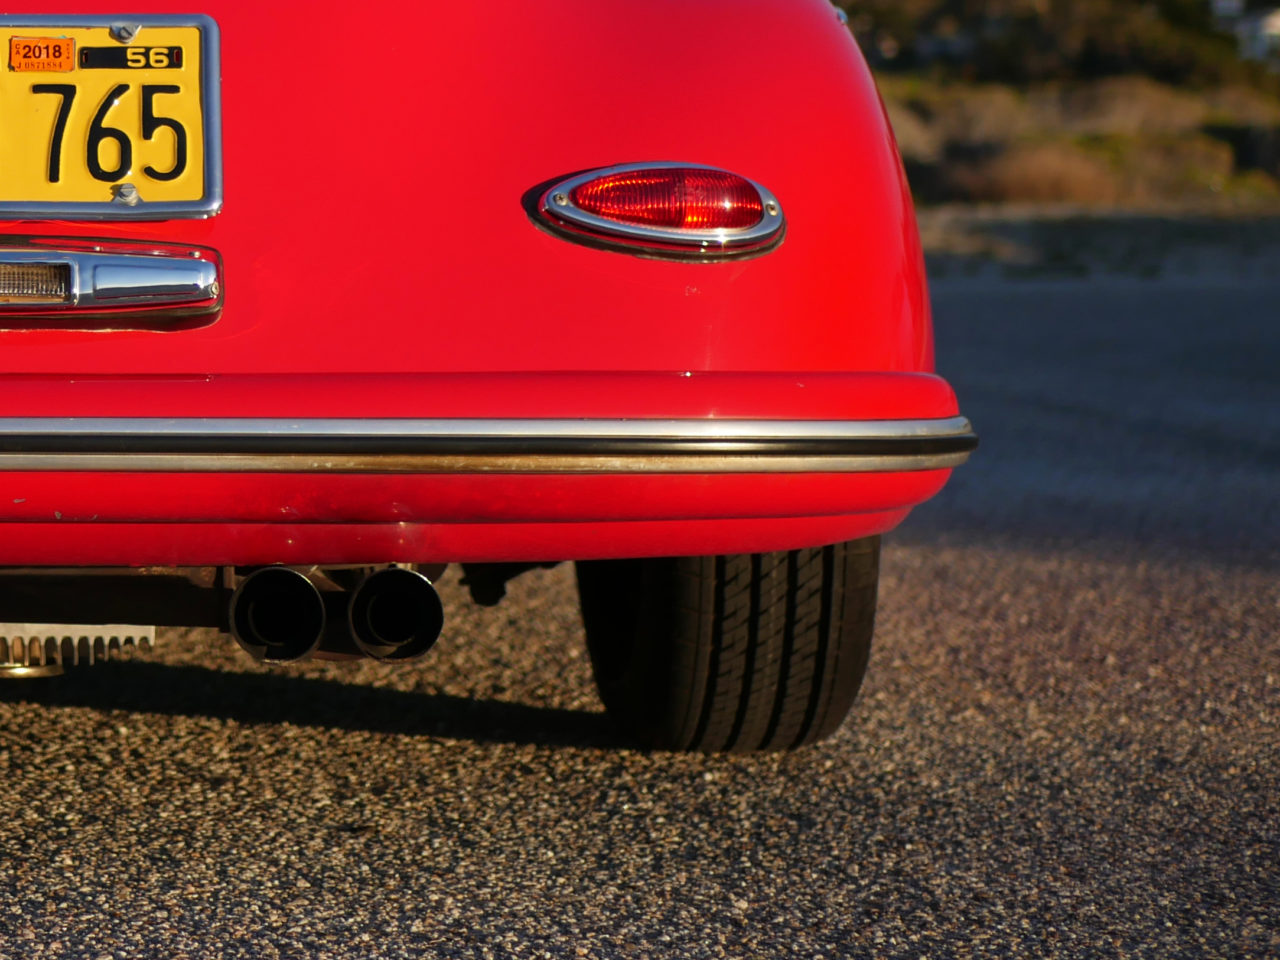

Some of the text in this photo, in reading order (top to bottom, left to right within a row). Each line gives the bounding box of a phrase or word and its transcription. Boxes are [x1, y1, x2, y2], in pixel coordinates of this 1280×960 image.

[22, 44, 62, 59] 2018
[126, 47, 170, 68] 56
[32, 84, 187, 182] 765
